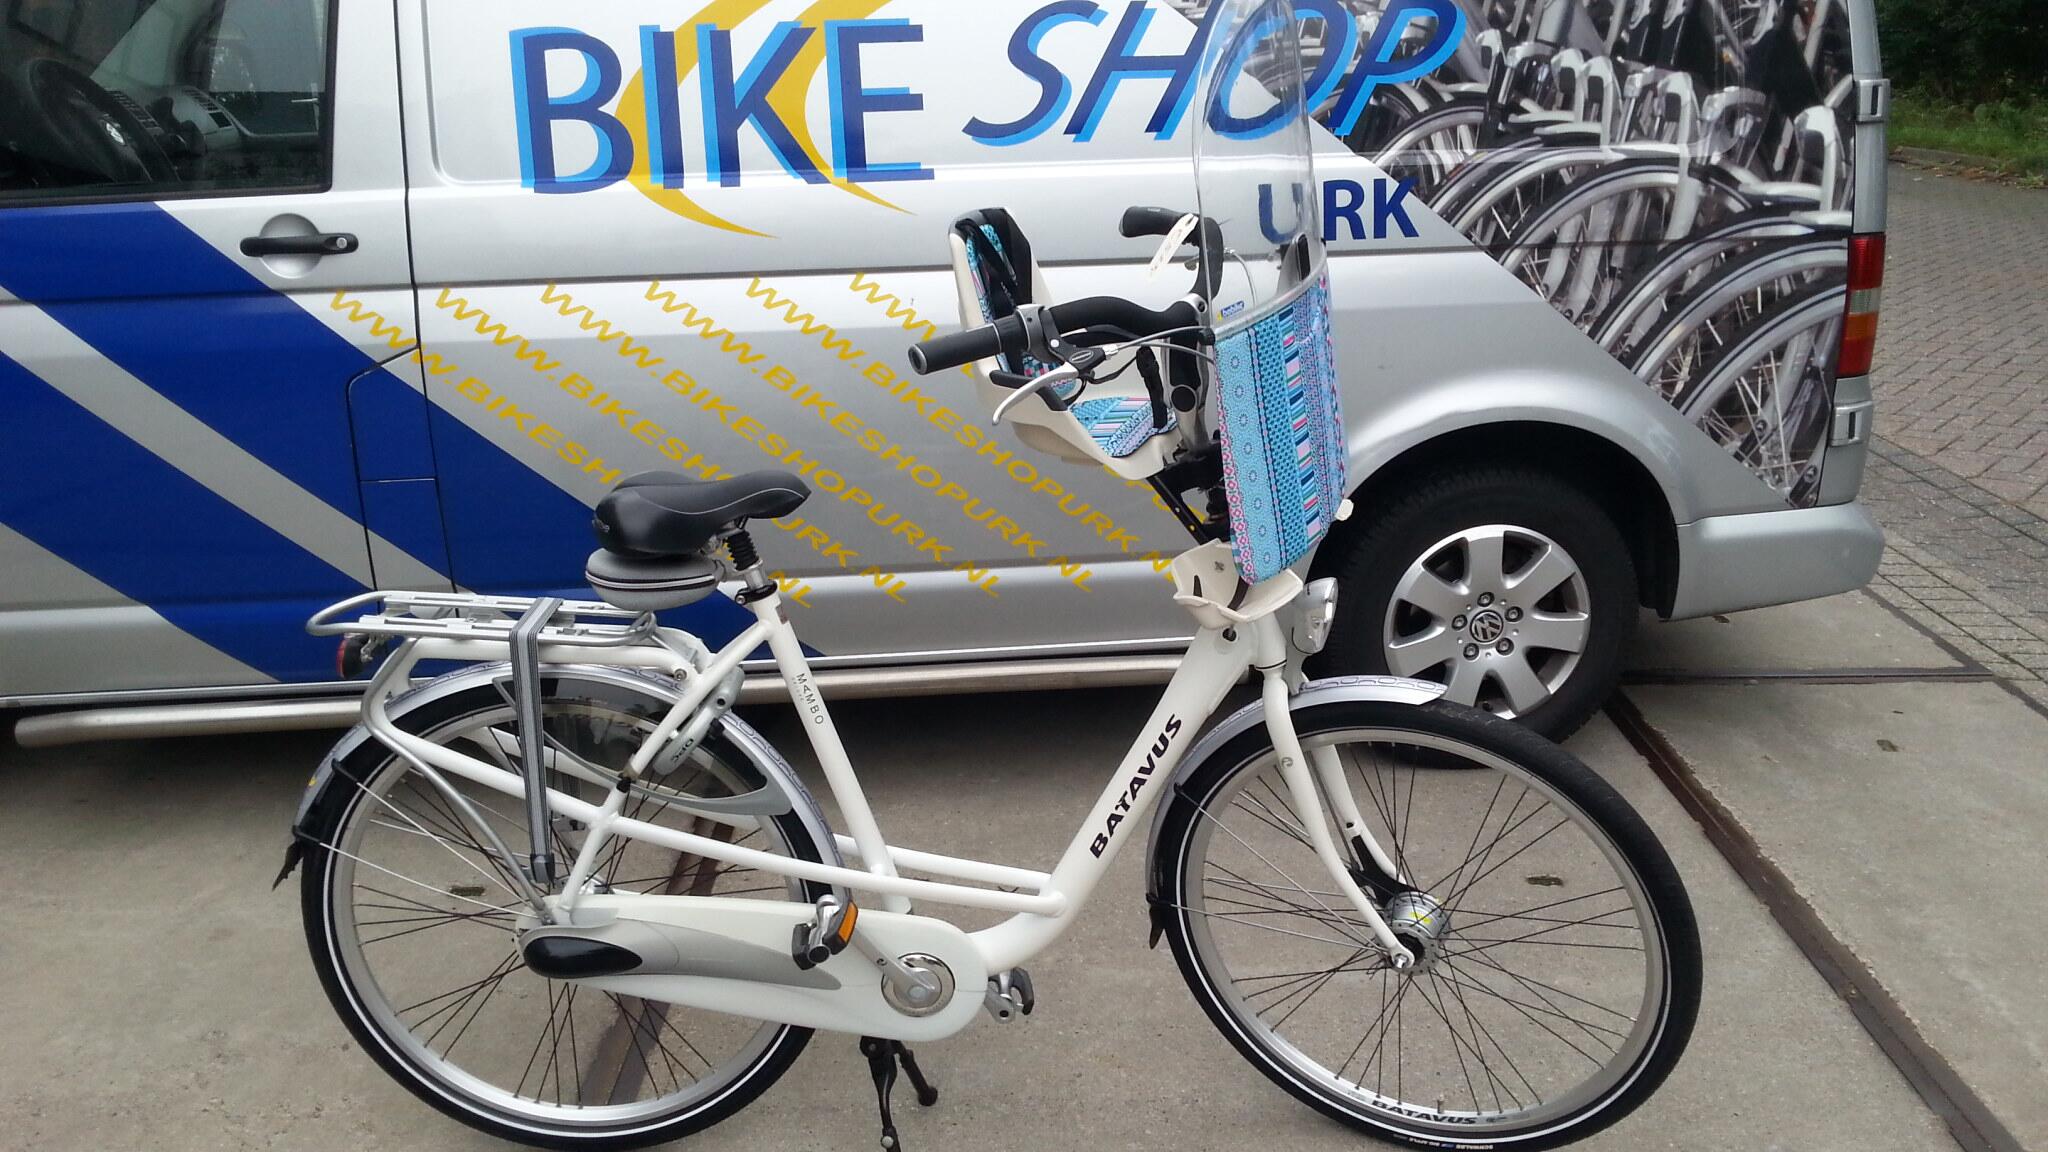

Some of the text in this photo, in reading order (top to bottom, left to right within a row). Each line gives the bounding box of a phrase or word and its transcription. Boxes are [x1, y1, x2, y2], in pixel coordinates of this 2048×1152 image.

[509, 0, 1466, 194] BIKE SHOP
[1258, 177, 1421, 245] URK
[436, 287, 907, 603] WWW.BIKESHURK.NL
[540, 282, 999, 598] WWW.BIKESHOPURK.NL
[644, 279, 1093, 593] WWW.BIKESHOPURK.NL
[796, 673, 823, 725] MAMBO
[1089, 714, 1182, 859] BATAVUS
[1372, 1100, 1477, 1125] BATAVUS
